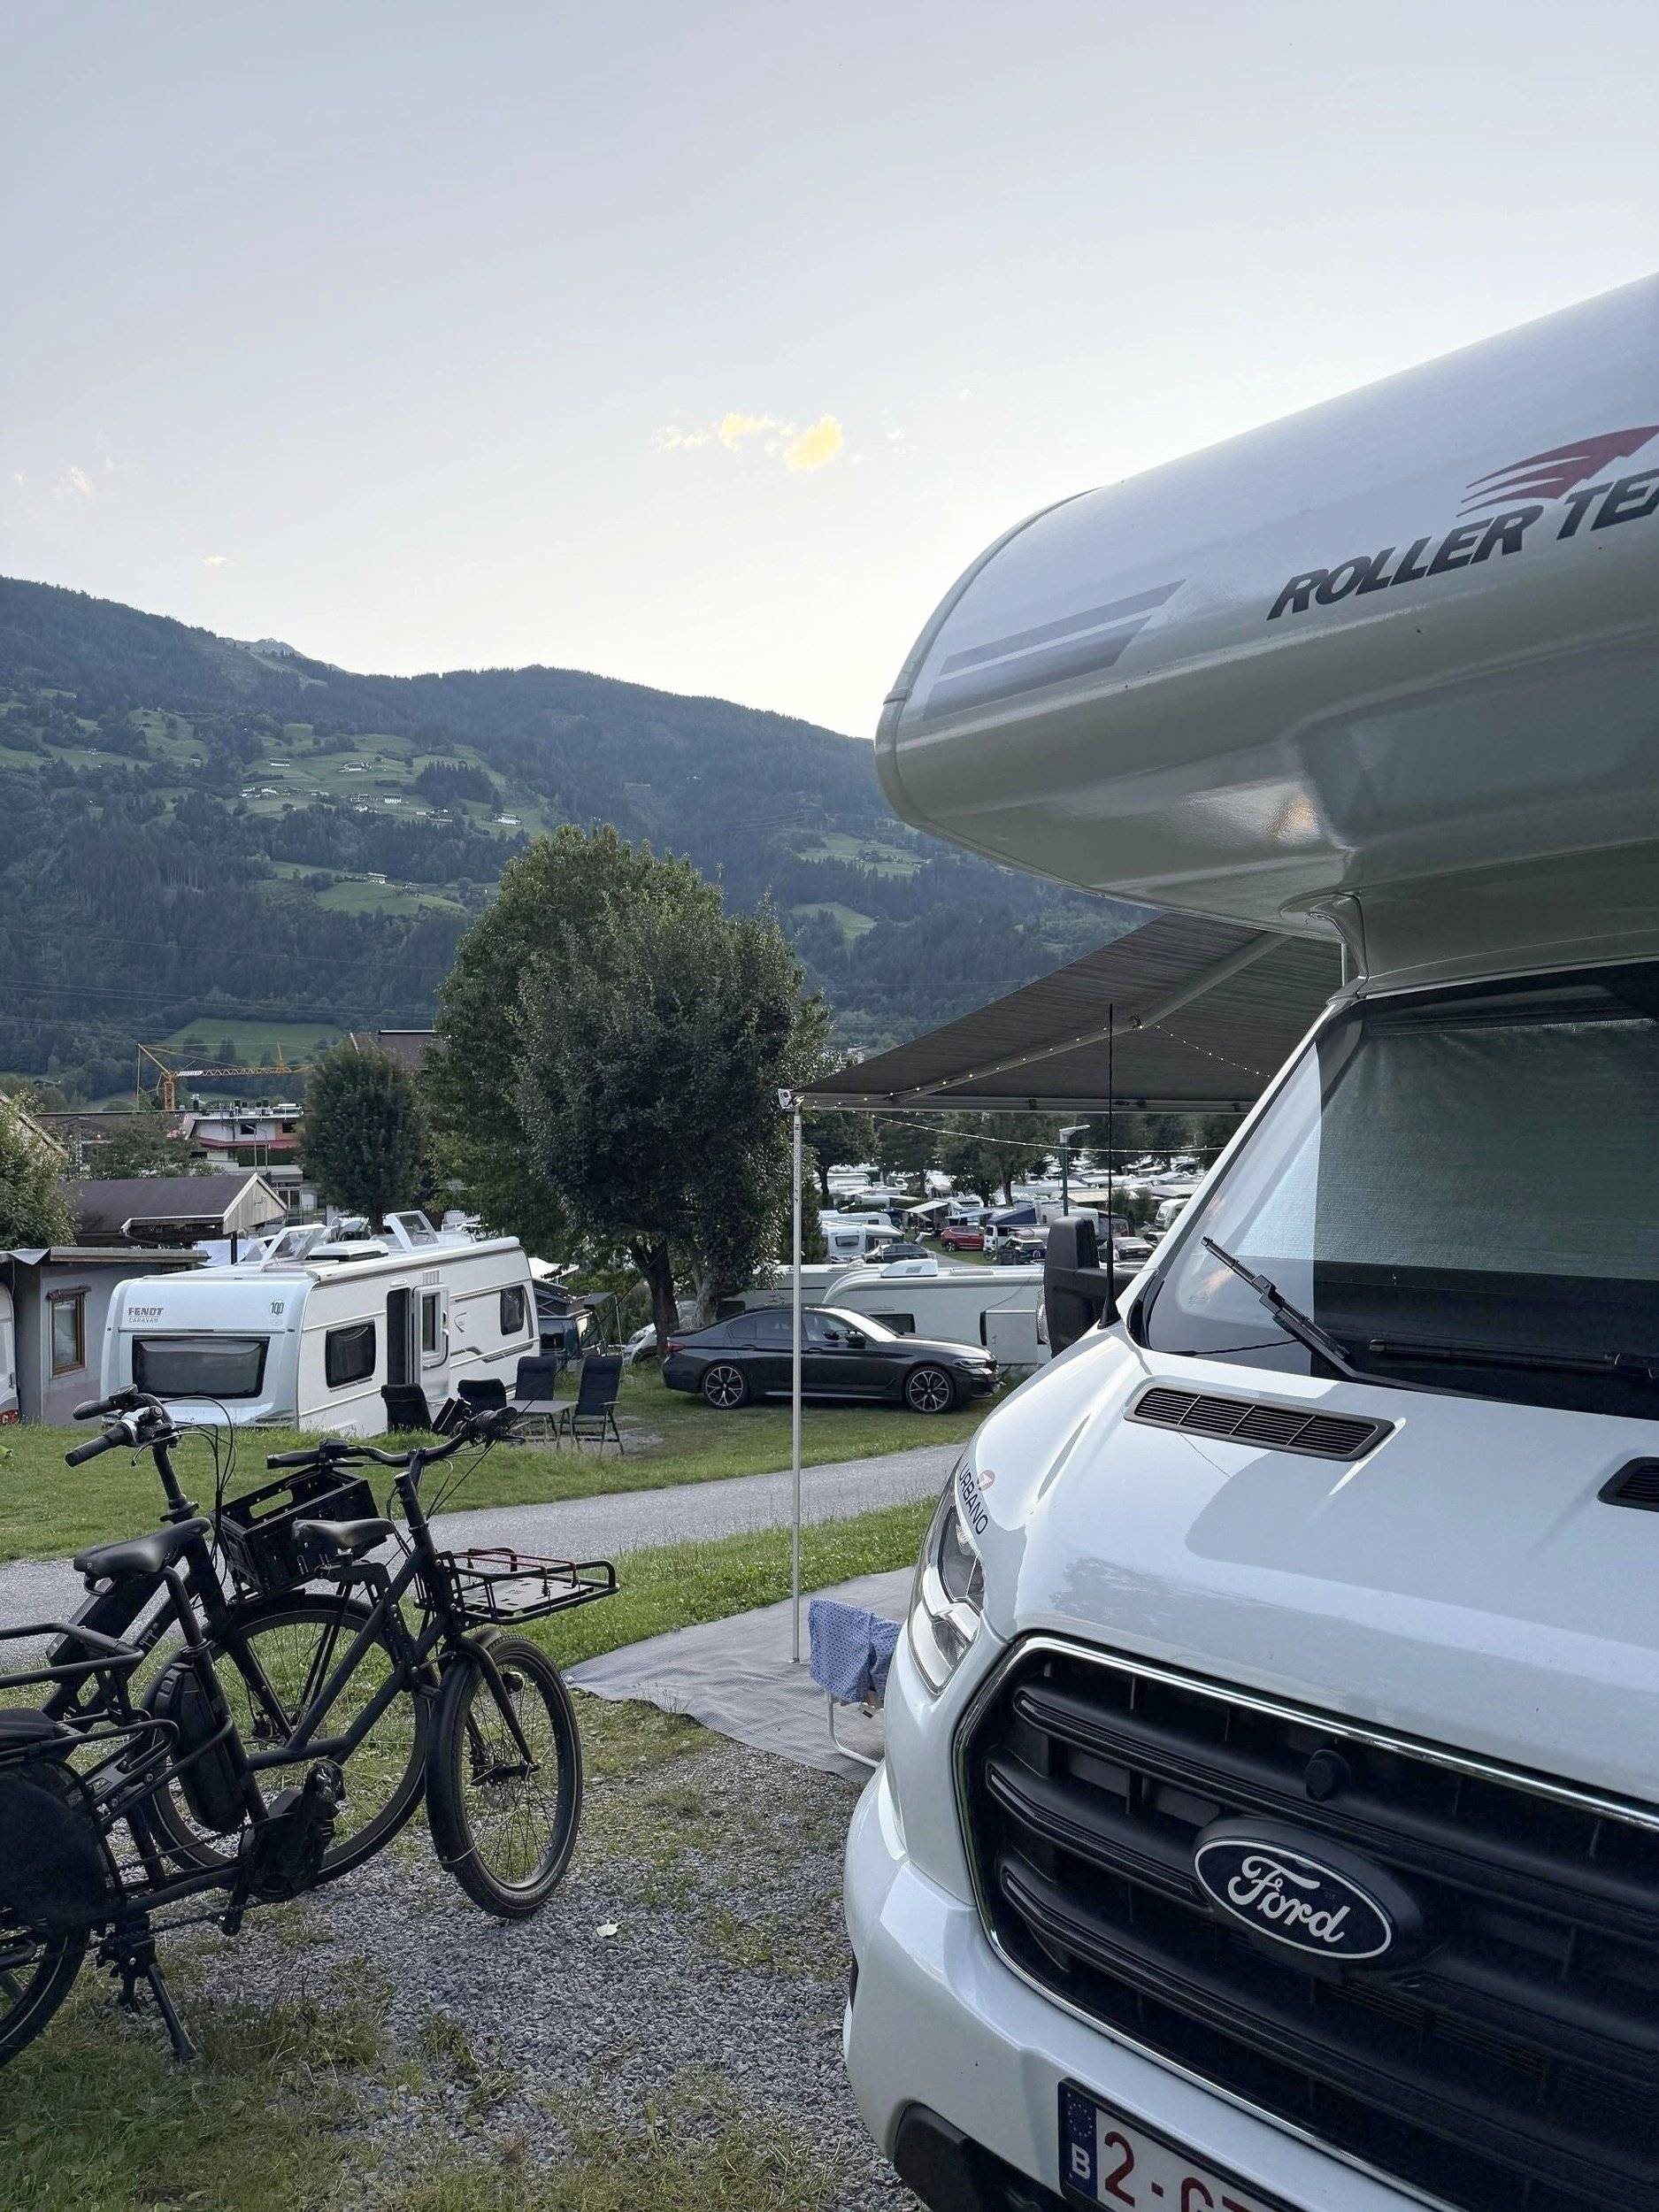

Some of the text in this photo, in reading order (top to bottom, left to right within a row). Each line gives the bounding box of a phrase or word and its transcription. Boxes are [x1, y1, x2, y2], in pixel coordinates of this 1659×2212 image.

[1266, 467, 1659, 621] ROLLER TE
[128, 1307, 164, 1316] FENDT
[958, 1462, 988, 1535] URBANO
[1227, 1855, 1351, 1943] Ford
[1071, 2143, 1091, 2179] B
